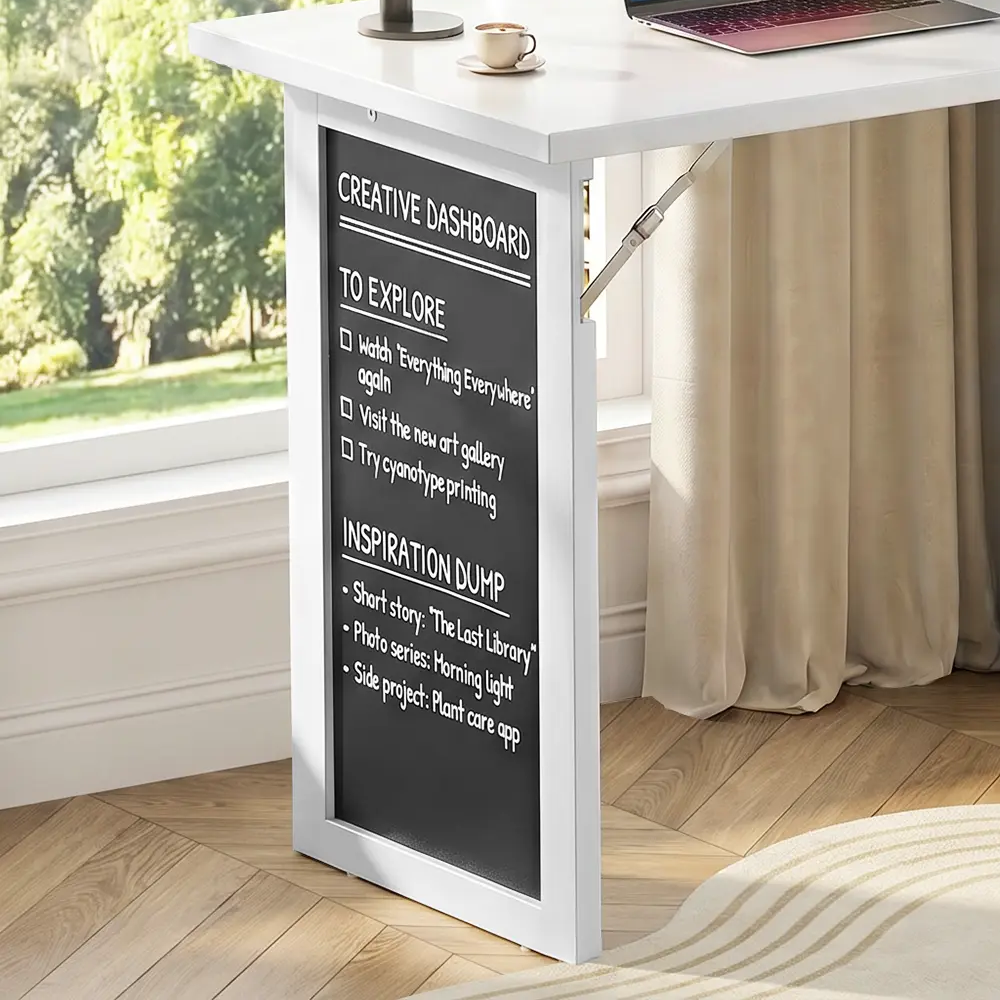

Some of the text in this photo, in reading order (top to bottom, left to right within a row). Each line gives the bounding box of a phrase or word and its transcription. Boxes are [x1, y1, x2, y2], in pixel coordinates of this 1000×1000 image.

[338, 172, 531, 260] CREATIVE DASHBOARD
[338, 266, 446, 330] TO EXPLORE
[357, 367, 392, 397] again
[358, 403, 505, 482] Visit the new art gallery
[358, 441, 498, 520] Try cyanotype printing
[343, 516, 505, 602] INSPIRATION DUMP
[352, 580, 388, 614] Short
[389, 595, 426, 636] story:
[457, 618, 484, 649] Last
[353, 620, 515, 706] Photo series: Morning light
[353, 661, 521, 753] Side project: Plant care app
